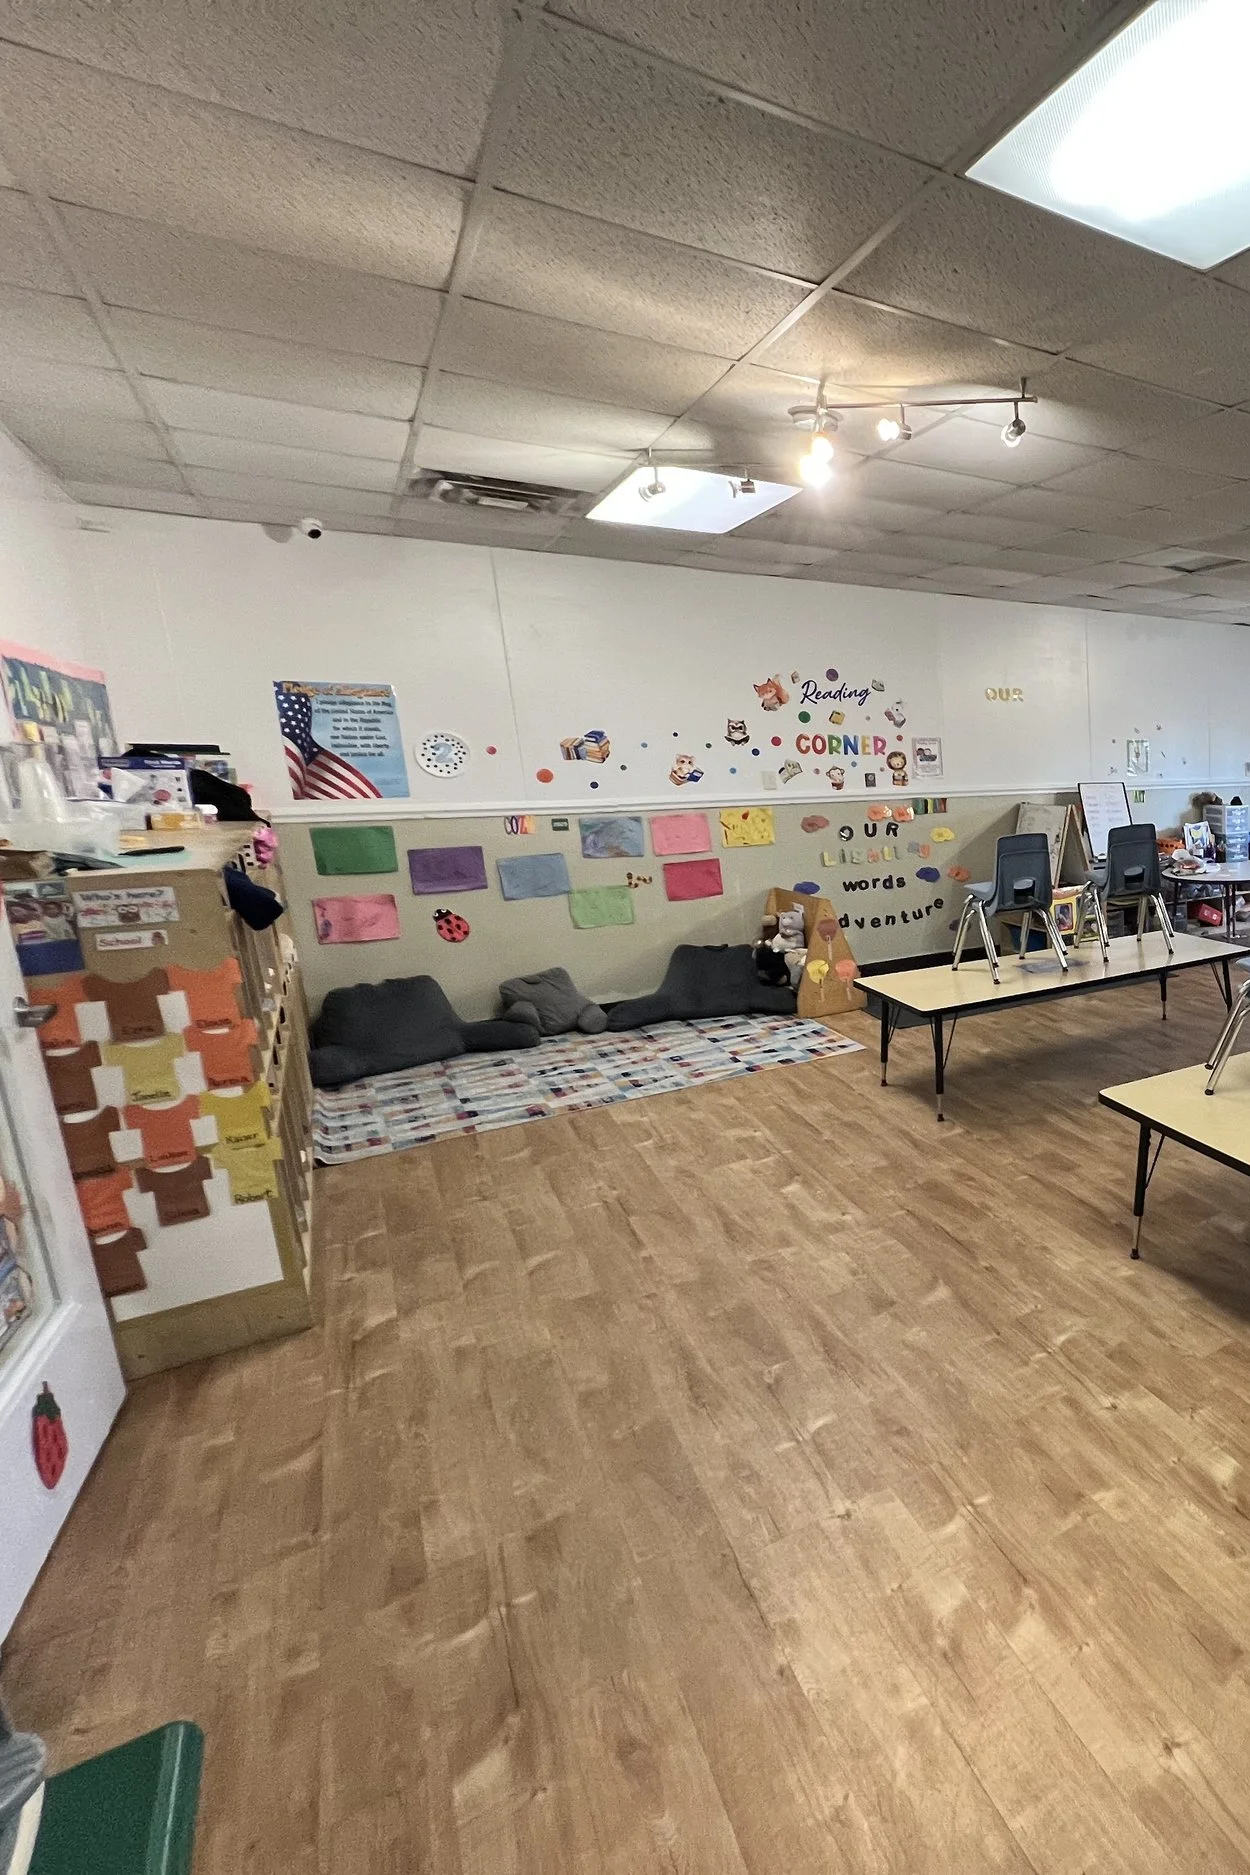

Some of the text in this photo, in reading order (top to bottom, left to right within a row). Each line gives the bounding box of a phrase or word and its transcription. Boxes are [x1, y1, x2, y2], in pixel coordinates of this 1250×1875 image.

[800, 679, 871, 706] Reading
[985, 687, 1024, 702] OUR
[433, 742, 454, 763] 2
[795, 733, 887, 755] CORNER
[839, 822, 899, 841] OUR
[842, 874, 906, 891] words
